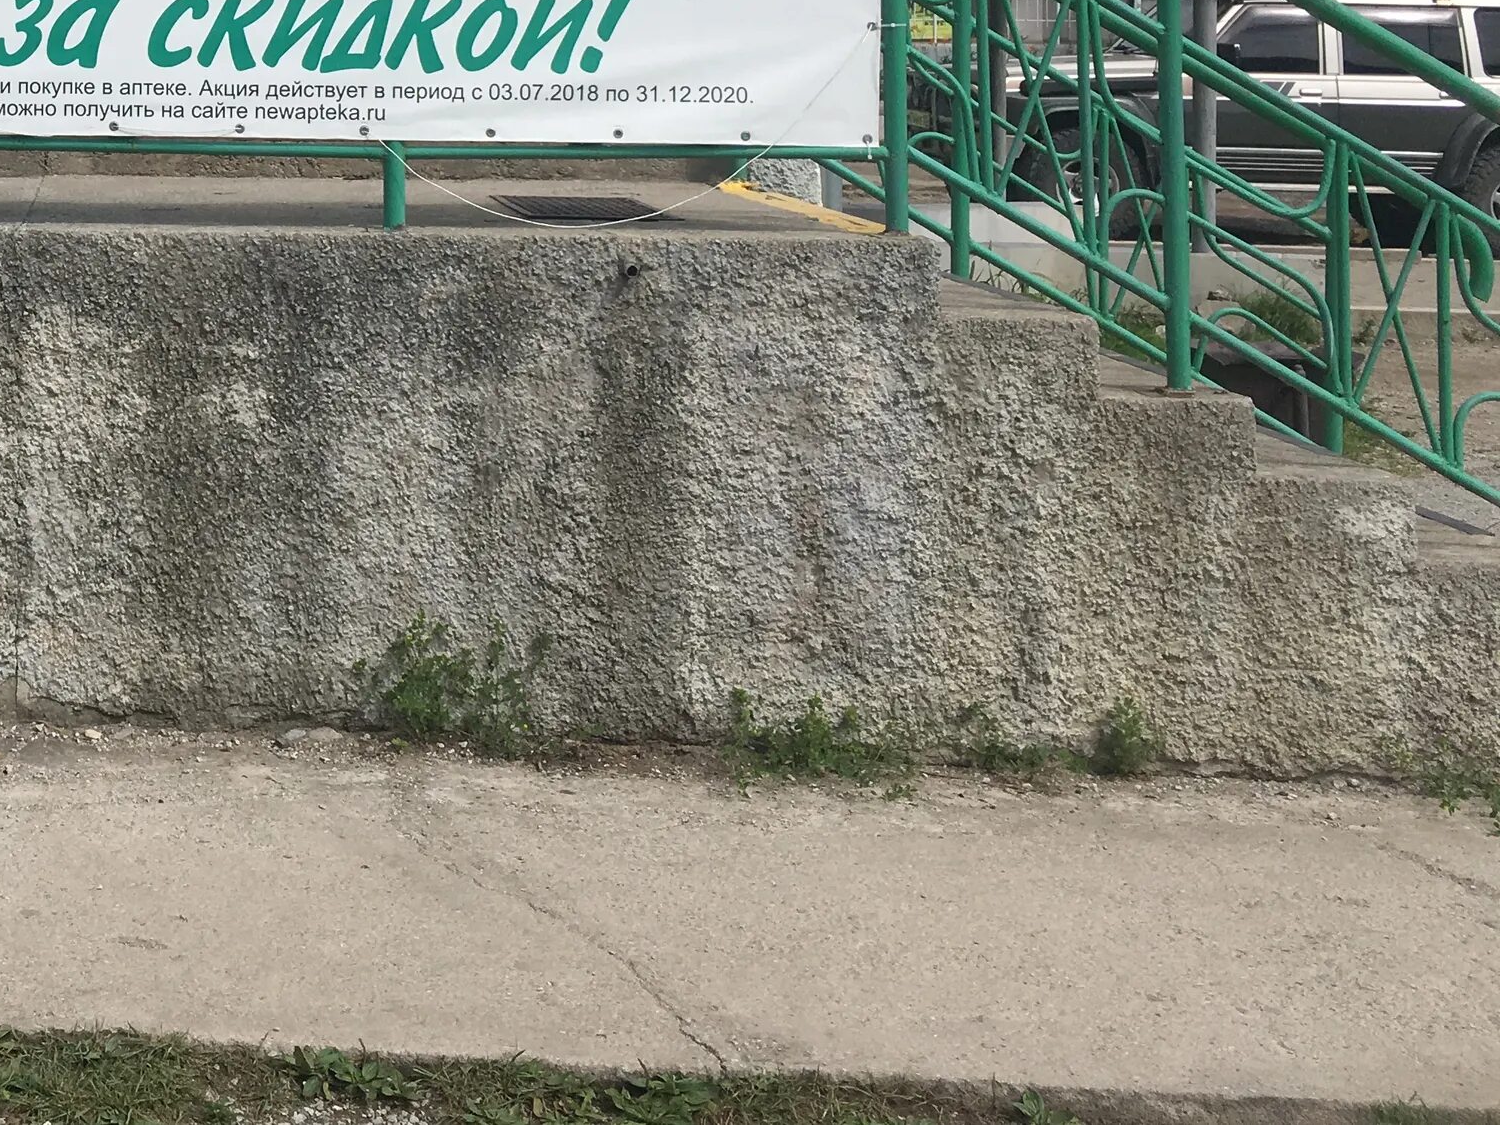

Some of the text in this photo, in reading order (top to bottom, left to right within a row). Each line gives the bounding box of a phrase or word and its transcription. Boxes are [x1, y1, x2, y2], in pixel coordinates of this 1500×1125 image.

[18, 81, 96, 98] покупке
[102, 82, 113, 95] в
[119, 82, 192, 96] аптеке.
[198, 80, 260, 99] Акция
[265, 81, 368, 100] действует
[374, 85, 386, 99] в
[392, 86, 465, 103] период
[471, 87, 483, 101] с
[488, 83, 599, 102] 03.07.2018
[606, 88, 630, 103] по
[636, 85, 754, 104] 31.12.2020.
[63, 104, 155, 120] получить
[161, 105, 185, 118] на
[191, 102, 249, 119] сайте
[254, 102, 387, 123] newapteka.ru
